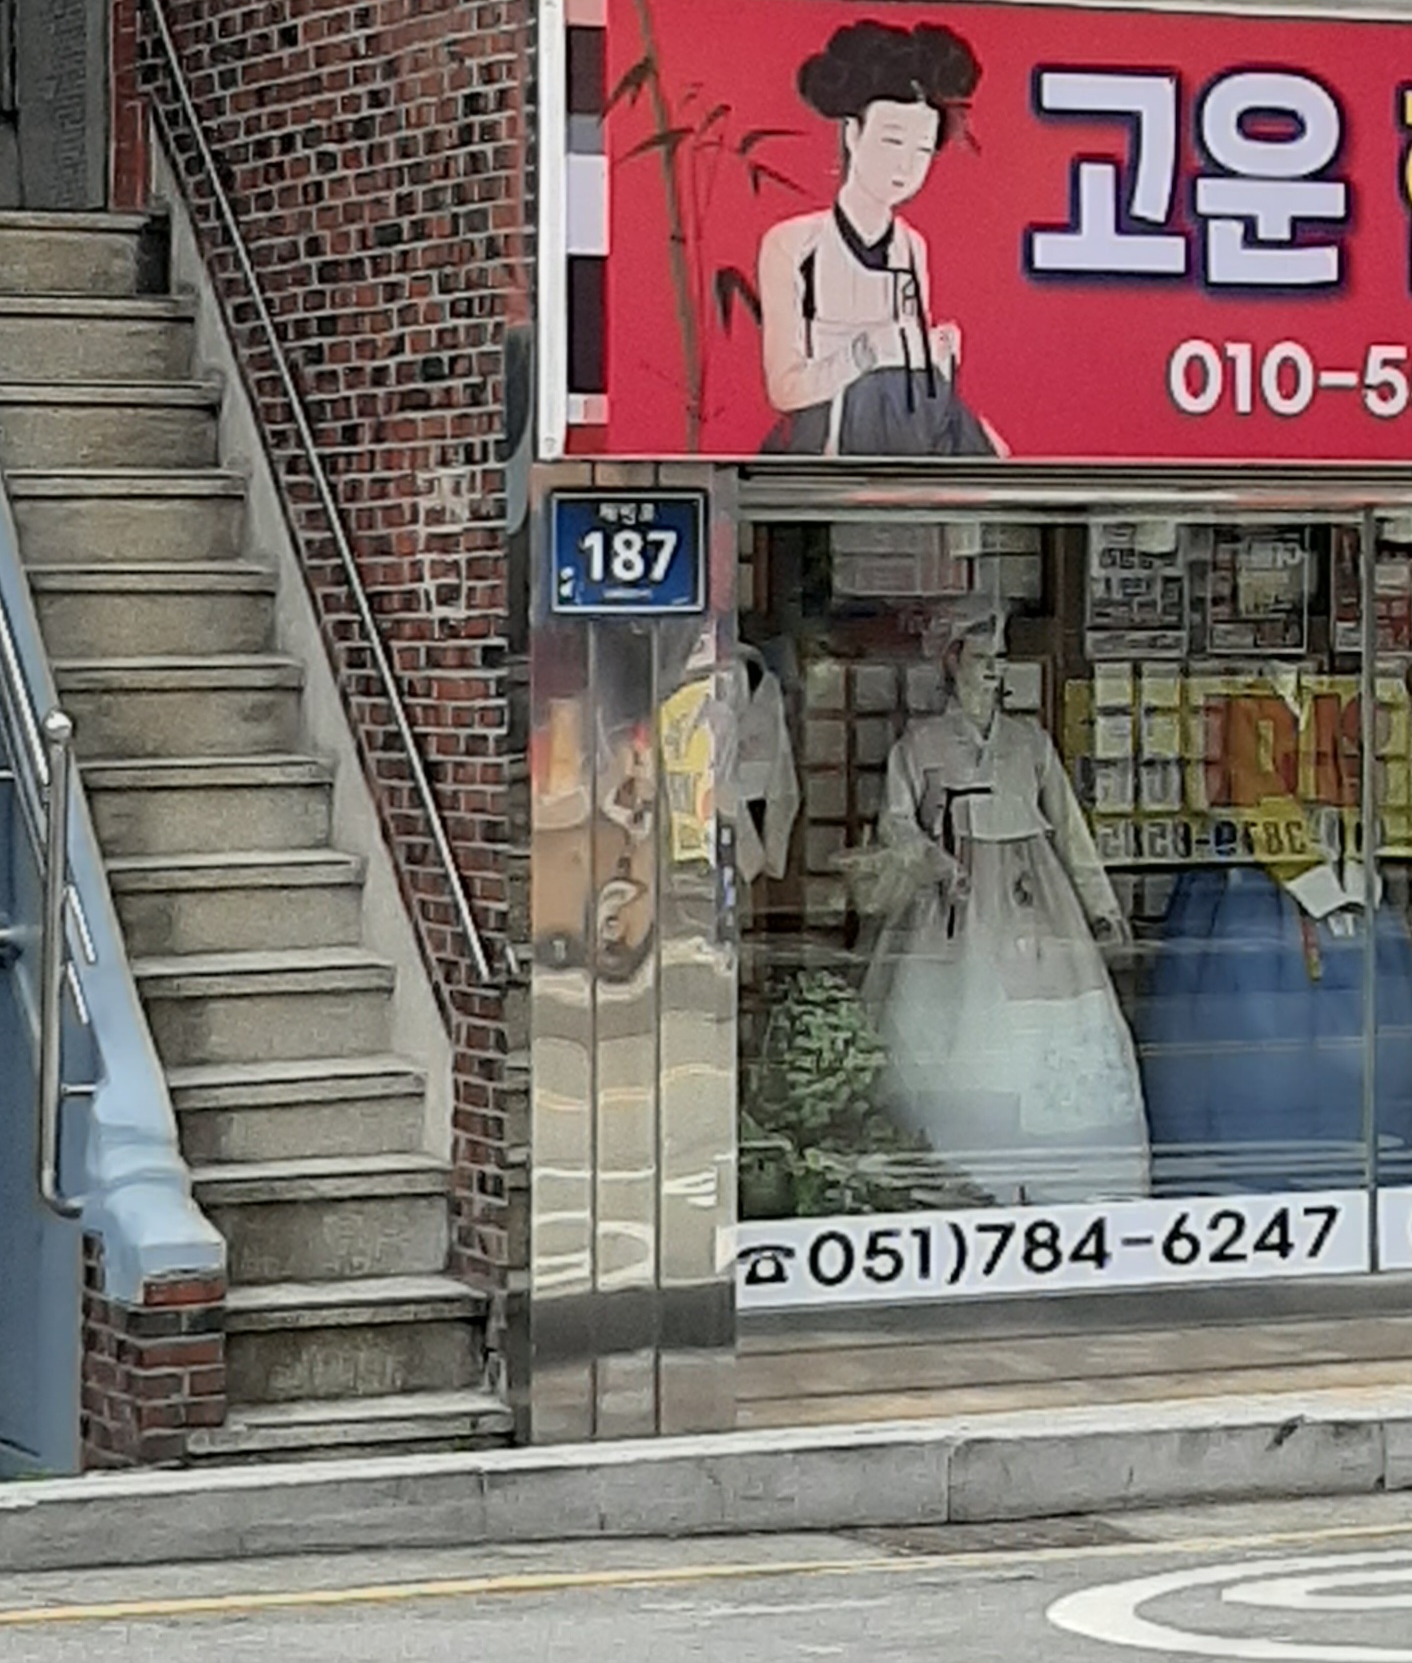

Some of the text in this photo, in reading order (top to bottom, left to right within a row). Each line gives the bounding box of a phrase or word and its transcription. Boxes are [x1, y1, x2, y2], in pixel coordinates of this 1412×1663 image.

[1028, 67, 1349, 288] 고운
[581, 528, 678, 582] 187
[807, 1204, 1342, 1287] 051)784-6247
